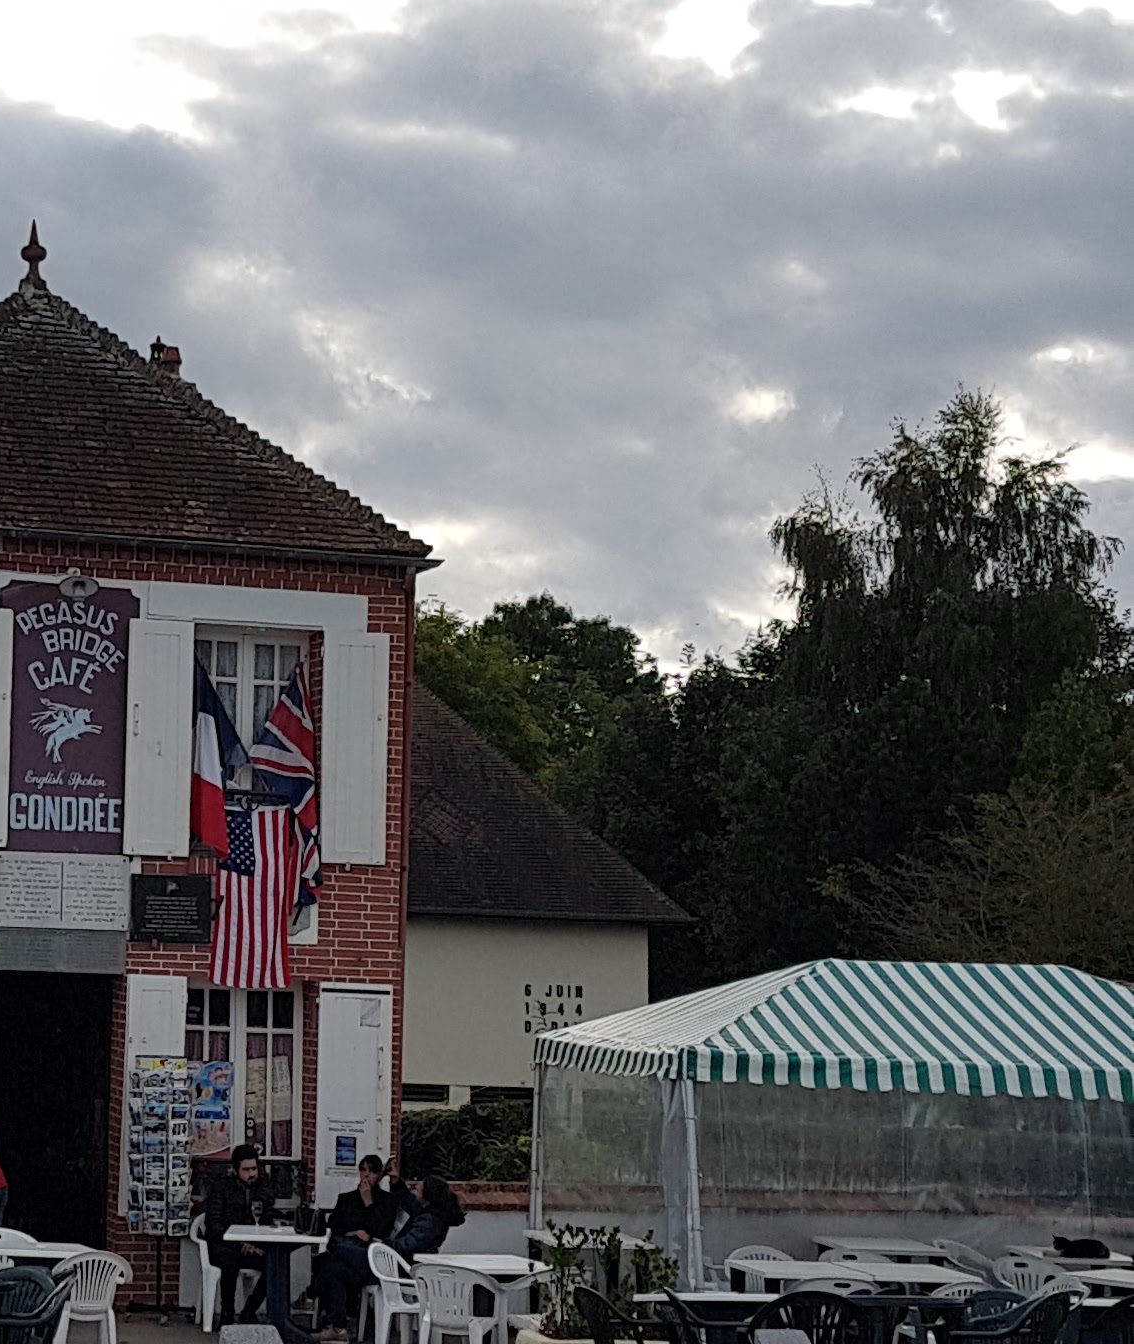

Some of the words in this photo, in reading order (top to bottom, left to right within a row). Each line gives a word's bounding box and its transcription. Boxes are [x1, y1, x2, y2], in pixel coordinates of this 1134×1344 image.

[16, 601, 119, 635] PEGASUS
[41, 628, 126, 673] BRIDGE
[28, 656, 102, 694] CAFÉ
[25, 769, 63, 790] English
[68, 772, 106, 790] Spoken
[9, 792, 122, 833] GONDRÉE
[525, 984, 531, 996] 6
[545, 984, 583, 998] JUIN
[525, 1002, 582, 1016] 1944
